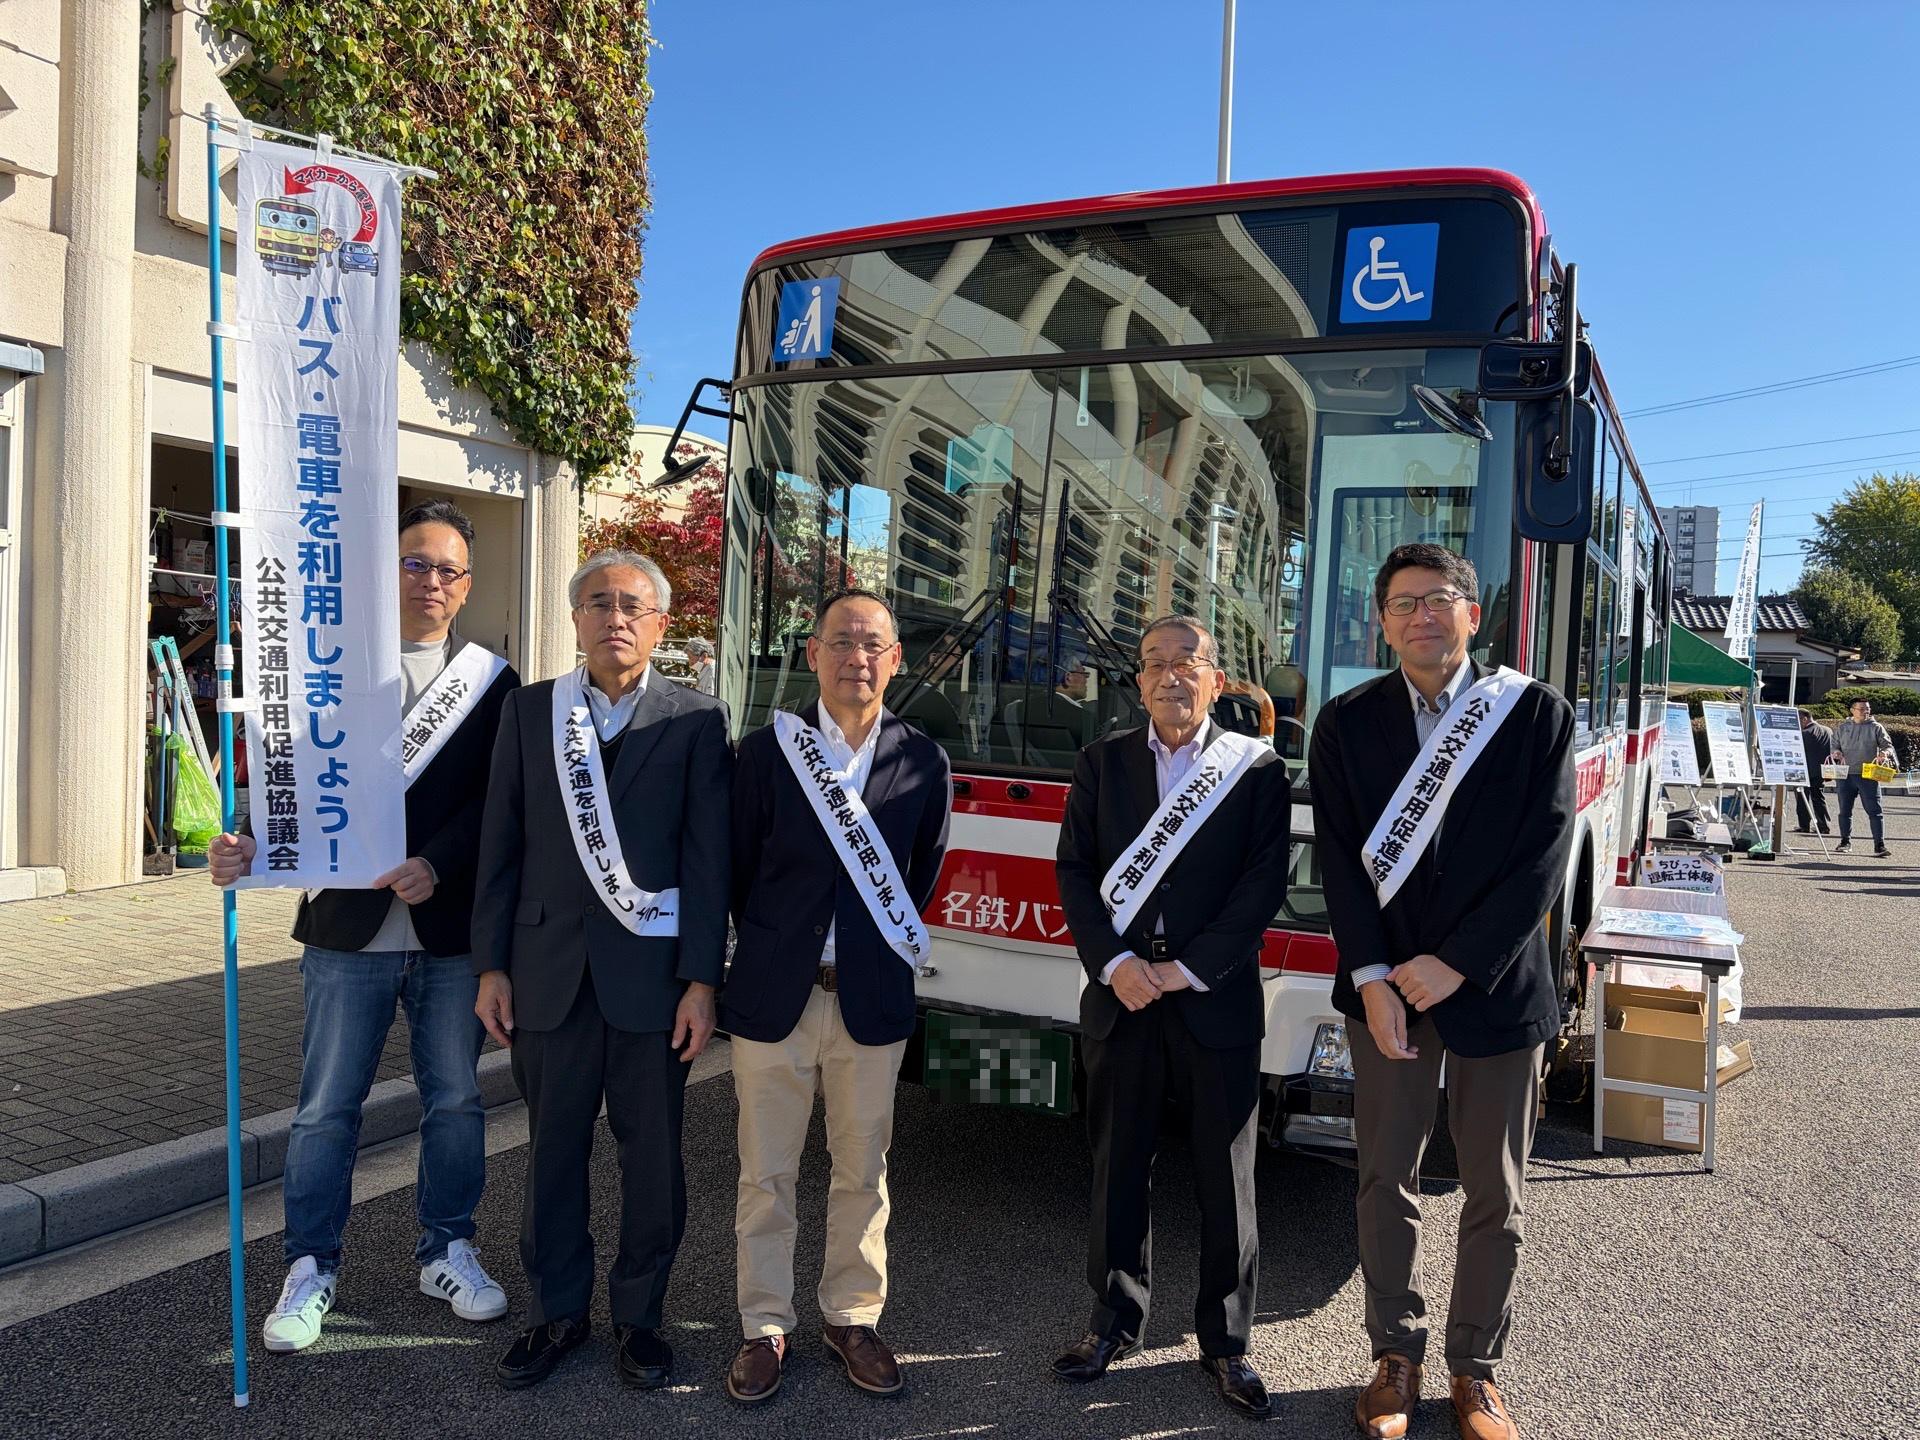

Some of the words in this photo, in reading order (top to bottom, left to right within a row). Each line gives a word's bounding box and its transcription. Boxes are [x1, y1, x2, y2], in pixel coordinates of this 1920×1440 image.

[256, 556, 299, 872] 公共交通利用促進協議会
[1659, 860, 1702, 869] ちびっこ
[1648, 870, 1714, 884] 運転士体験
